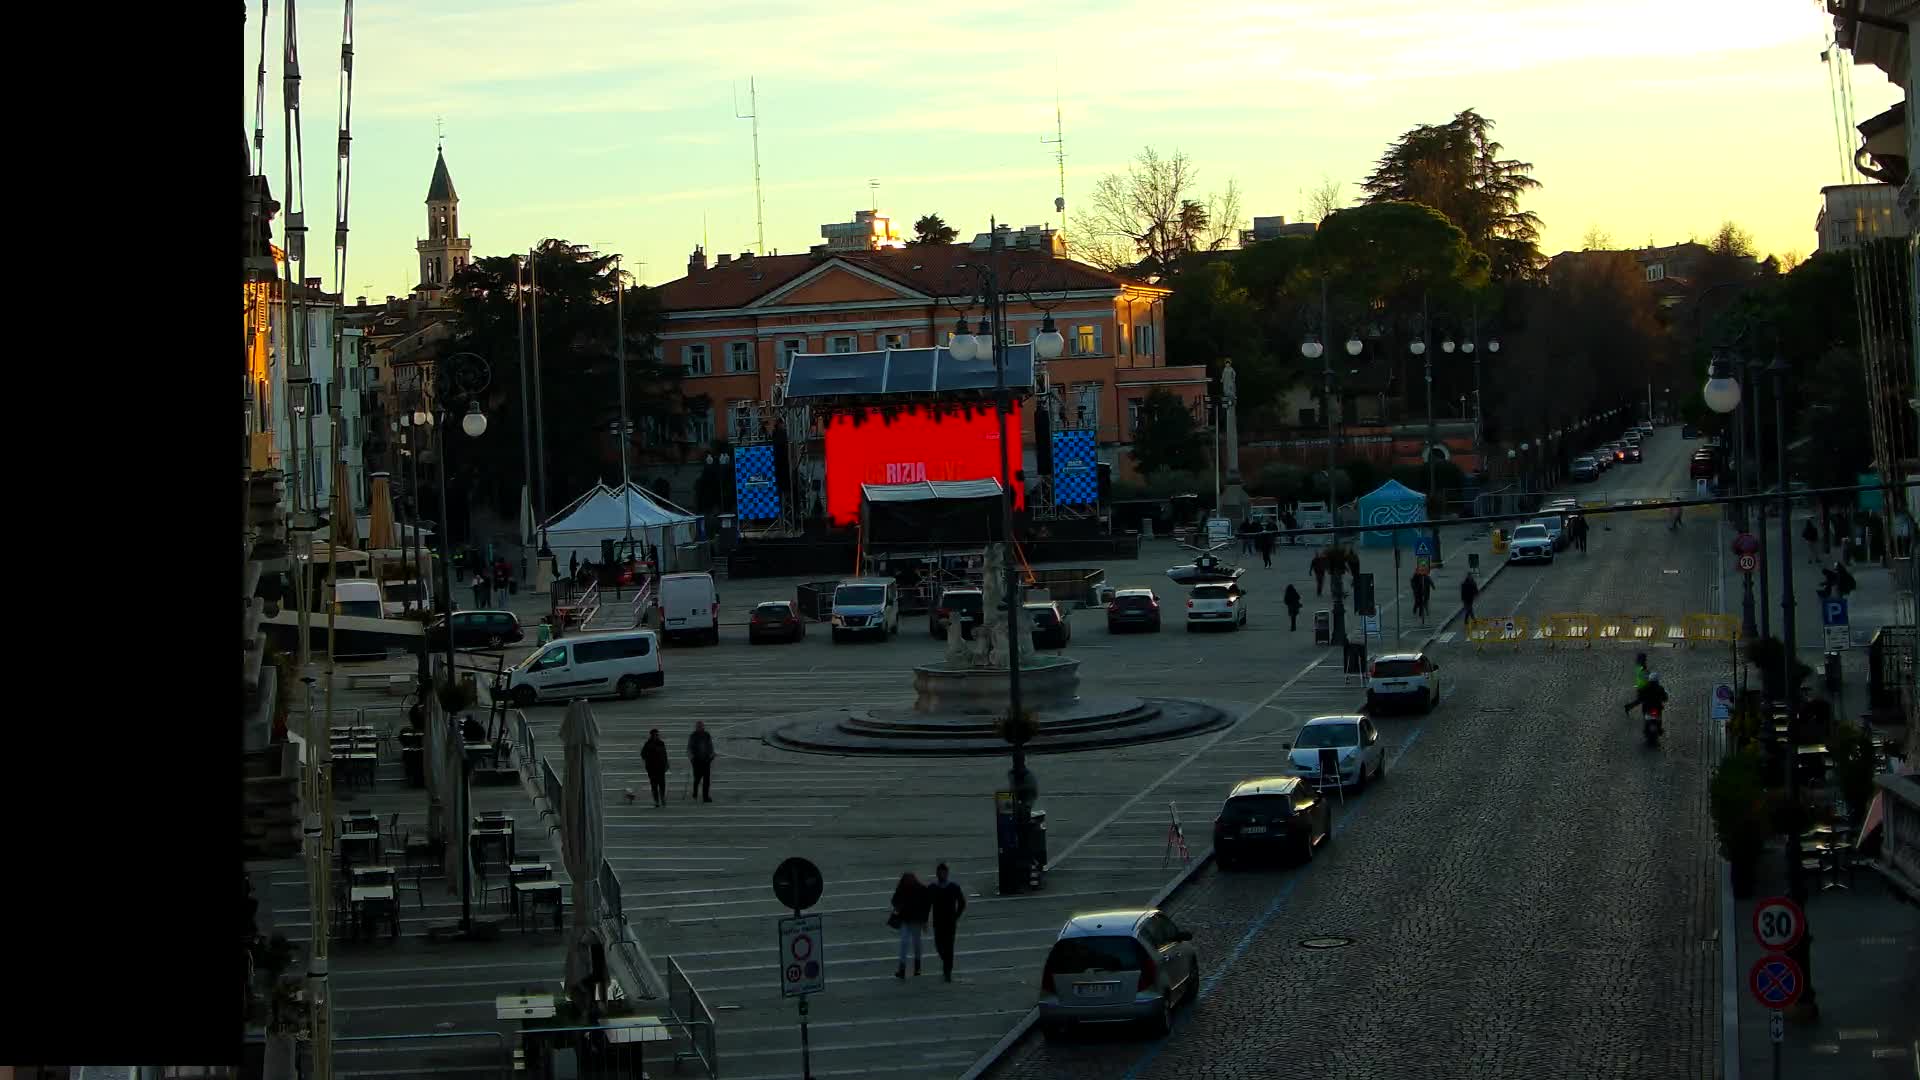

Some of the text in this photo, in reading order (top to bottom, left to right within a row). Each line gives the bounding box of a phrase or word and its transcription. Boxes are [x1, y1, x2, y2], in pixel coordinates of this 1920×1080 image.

[1743, 558, 1753, 567] 20
[1827, 602, 1842, 622] P
[1762, 911, 1792, 938] 30
